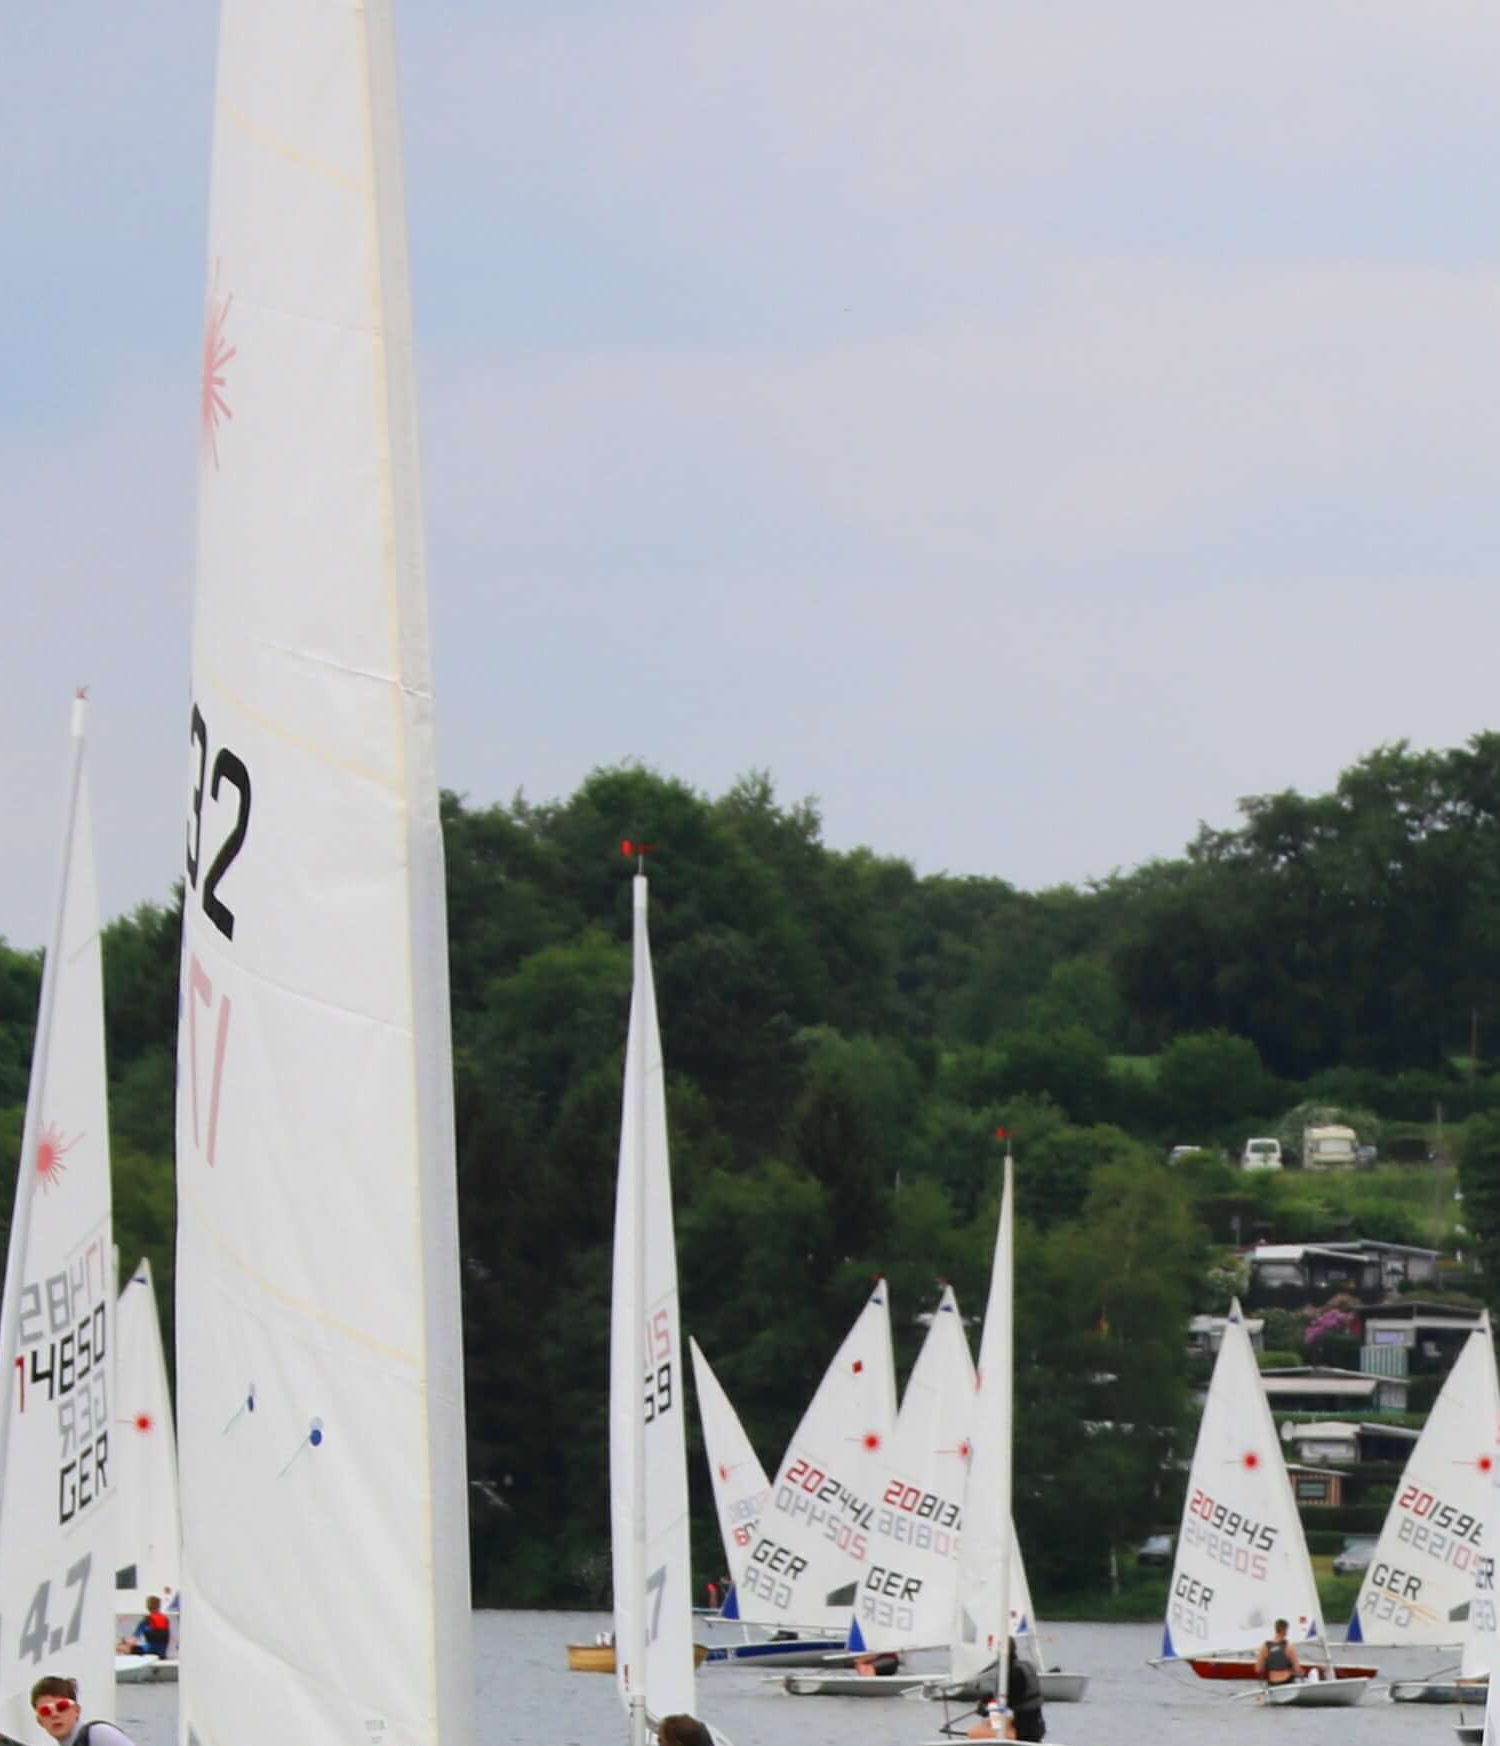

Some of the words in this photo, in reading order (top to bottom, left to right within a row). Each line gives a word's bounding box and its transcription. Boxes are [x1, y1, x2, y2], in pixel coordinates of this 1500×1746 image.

[58, 1429, 109, 1526] GER
[1189, 1488, 1279, 1552] 209945
[750, 1537, 809, 1582] GER
[1371, 1563, 1422, 1601] GER
[865, 1565, 923, 1602] GER
[1174, 1573, 1215, 1612] GER
[17, 1551, 93, 1666] 4.7
